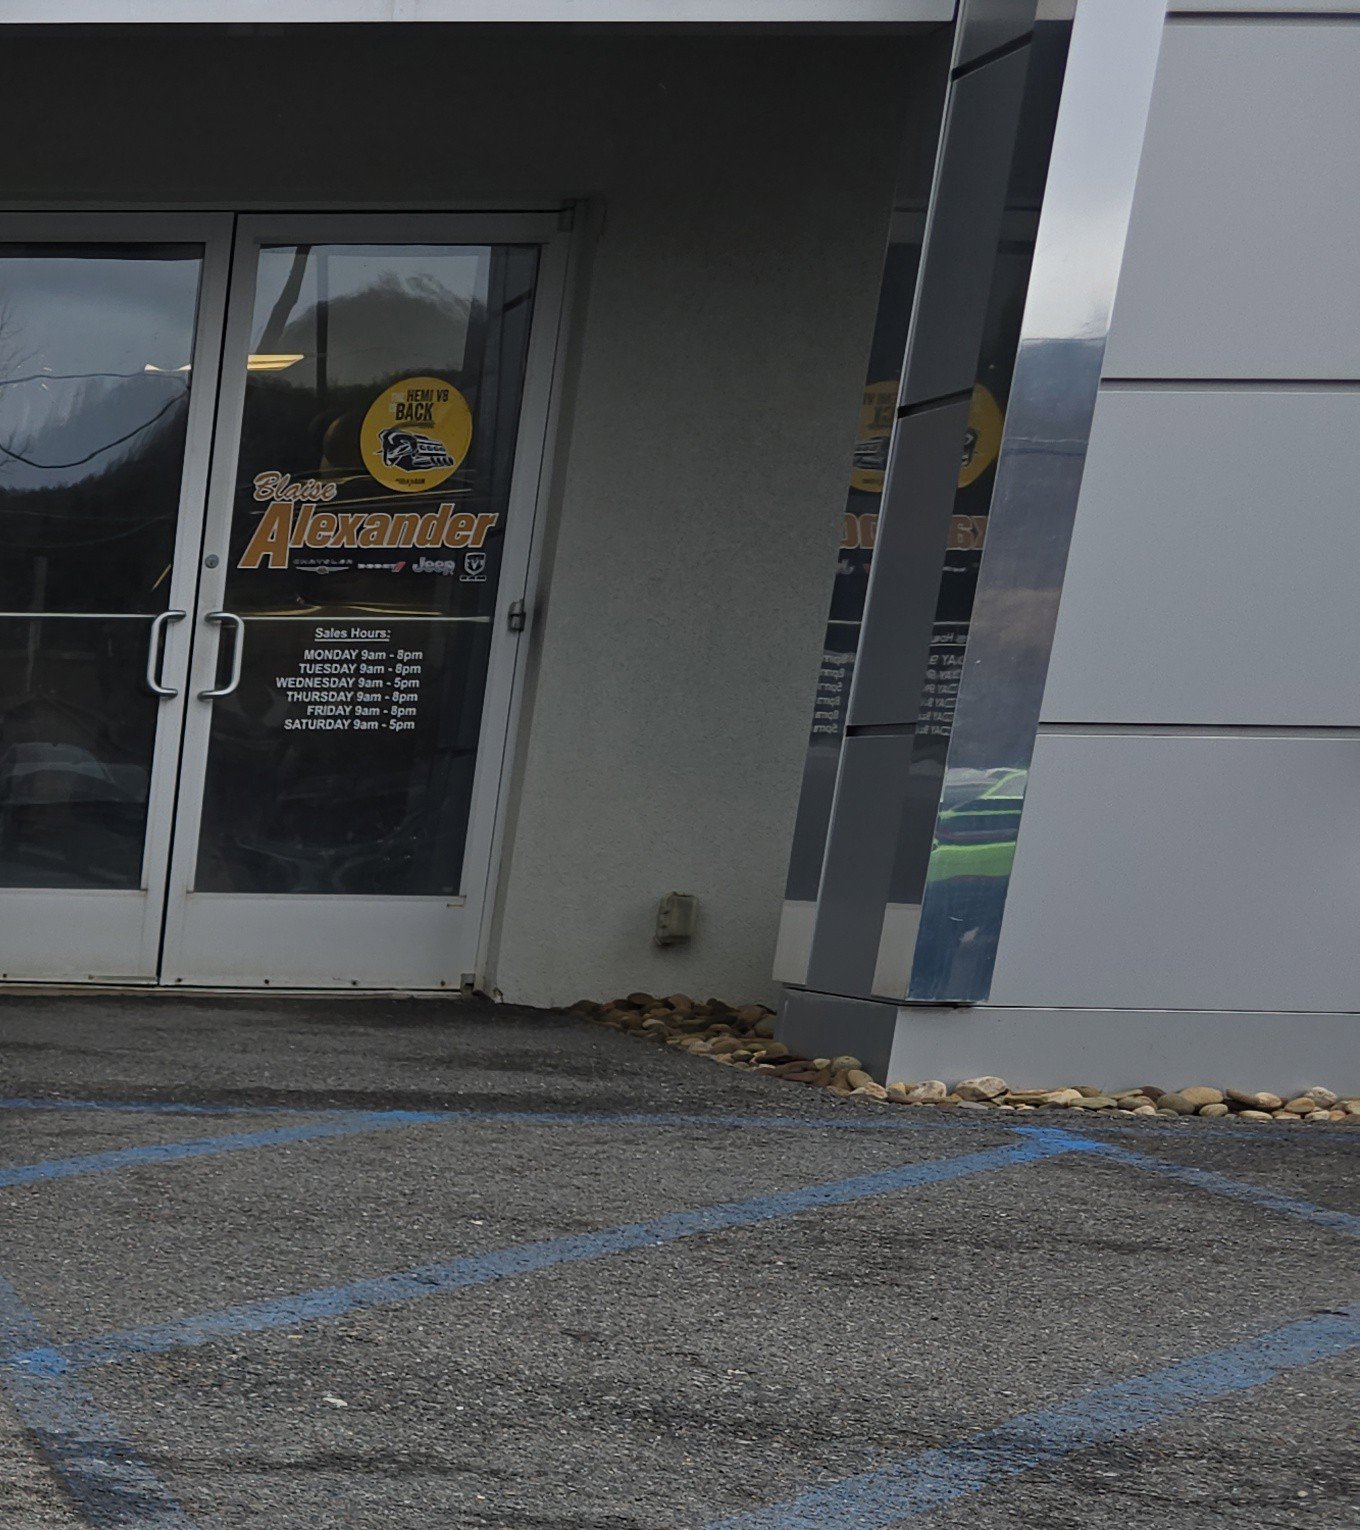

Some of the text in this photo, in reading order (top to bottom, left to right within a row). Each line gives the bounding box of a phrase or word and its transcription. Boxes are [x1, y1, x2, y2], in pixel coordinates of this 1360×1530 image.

[406, 389, 434, 402] HEMI
[436, 389, 450, 403] V8
[395, 402, 434, 421] BACK
[253, 471, 337, 501] Blaise
[237, 501, 499, 569] Alexander
[412, 556, 456, 576] Jeep
[314, 627, 391, 638] Sales Hours:
[303, 649, 359, 661] MONDAY
[361, 649, 386, 661] 9am
[397, 649, 423, 662] 8pm
[299, 663, 357, 674] TUESDAY
[359, 663, 385, 674] 9am
[395, 663, 421, 675] 8pm
[276, 677, 355, 688] WEDNESDAY
[357, 677, 383, 688] 9am
[394, 677, 420, 690] 5pm
[286, 691, 354, 702] THURSDAY
[356, 691, 382, 702] 9am
[392, 691, 418, 704] 8pm
[306, 705, 352, 716] FRIDAY
[354, 705, 380, 716] 9am
[390, 705, 417, 718] 8pm
[283, 719, 351, 730] SATURDAY
[353, 719, 378, 730] 9am
[388, 719, 415, 732] 5pm
